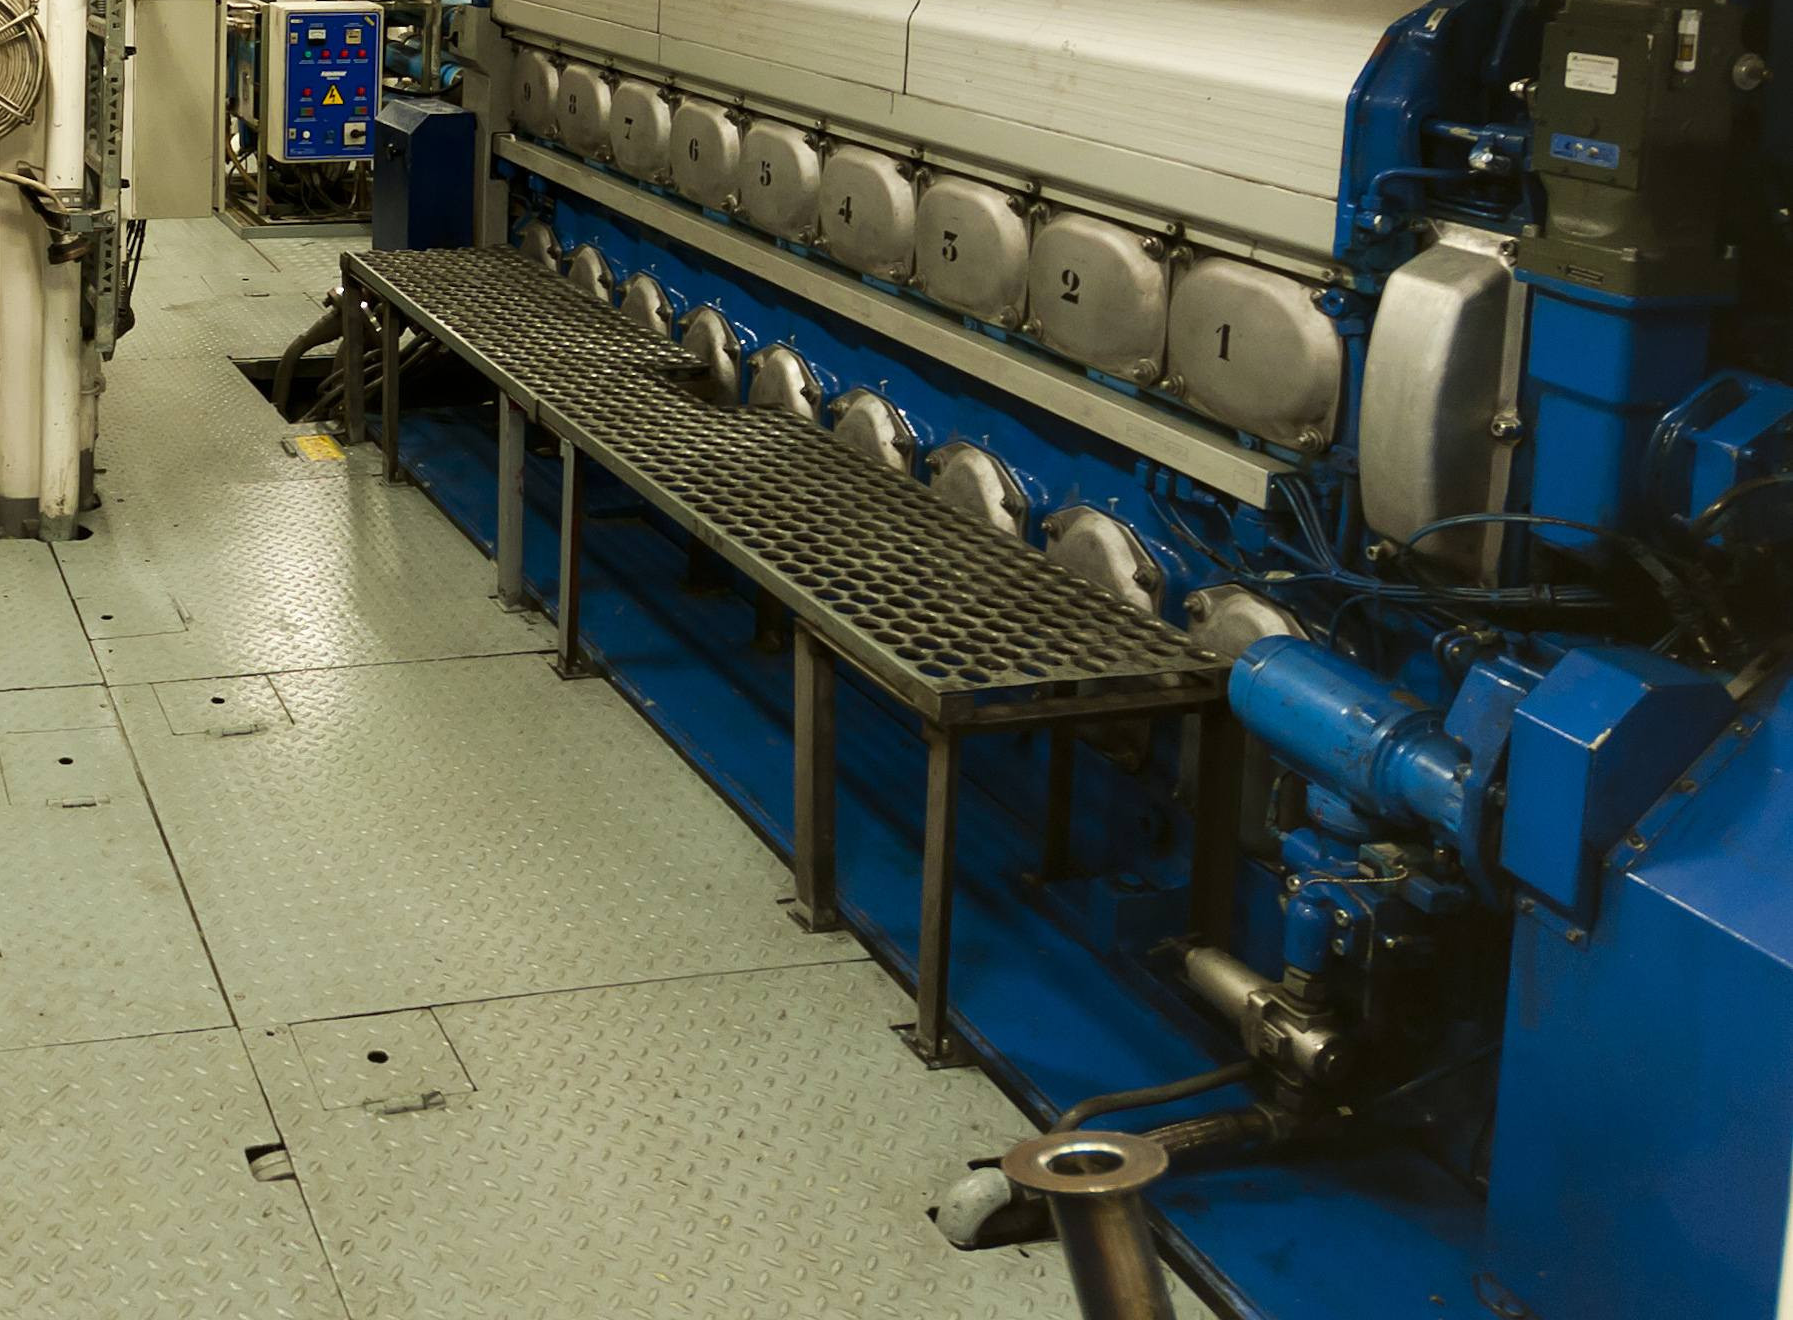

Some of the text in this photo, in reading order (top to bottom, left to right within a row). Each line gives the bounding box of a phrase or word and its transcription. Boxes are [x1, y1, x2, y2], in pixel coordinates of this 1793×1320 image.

[568, 93, 577, 115] 8
[624, 116, 634, 141] 7
[688, 138, 699, 162] 6
[759, 160, 772, 187] 5
[837, 196, 853, 225] 4
[941, 230, 958, 262] 3
[1060, 269, 1080, 305] 2
[1215, 323, 1231, 362] 1
